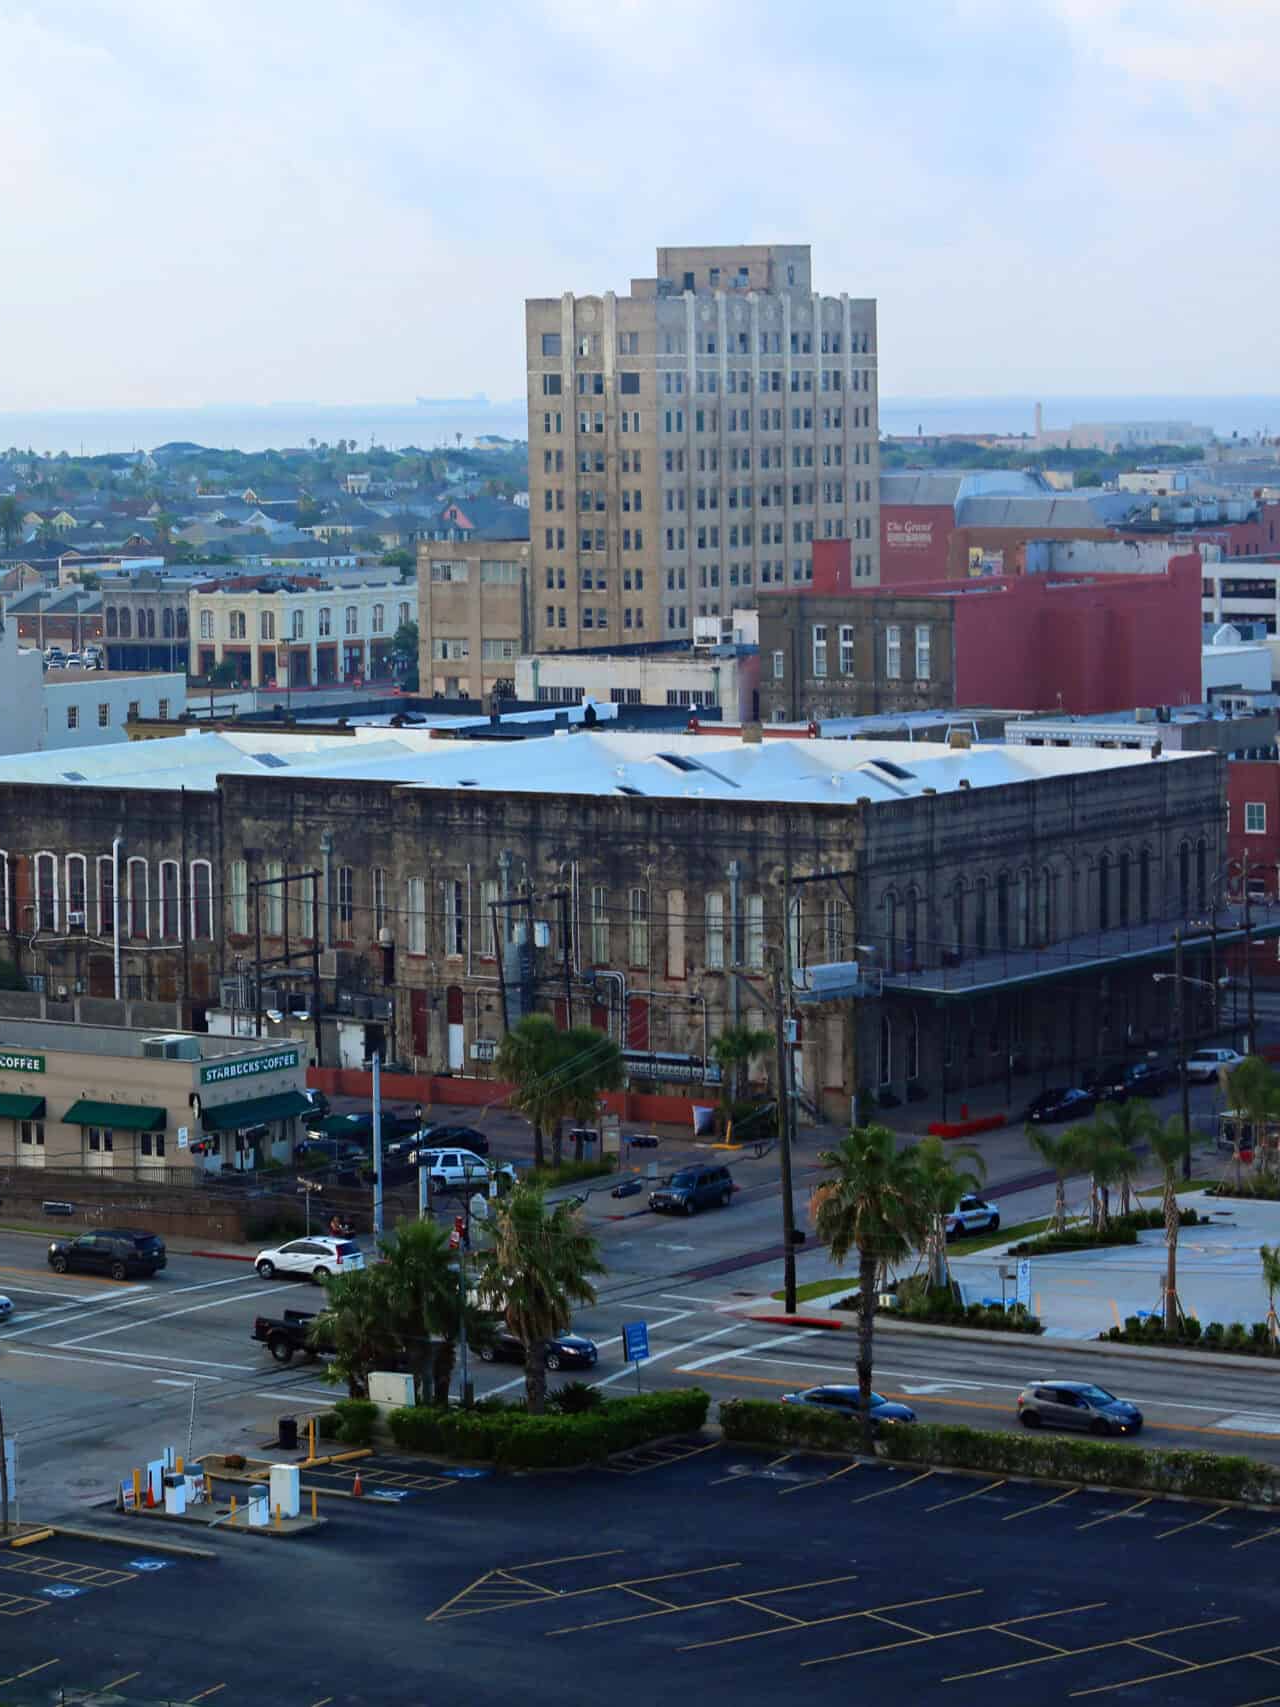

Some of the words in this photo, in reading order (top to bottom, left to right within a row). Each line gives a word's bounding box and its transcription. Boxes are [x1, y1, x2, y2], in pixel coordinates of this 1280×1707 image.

[0, 1056, 41, 1070] COFFEE
[206, 1063, 260, 1081] STARBUCKS
[263, 1054, 295, 1070] COFFEE
